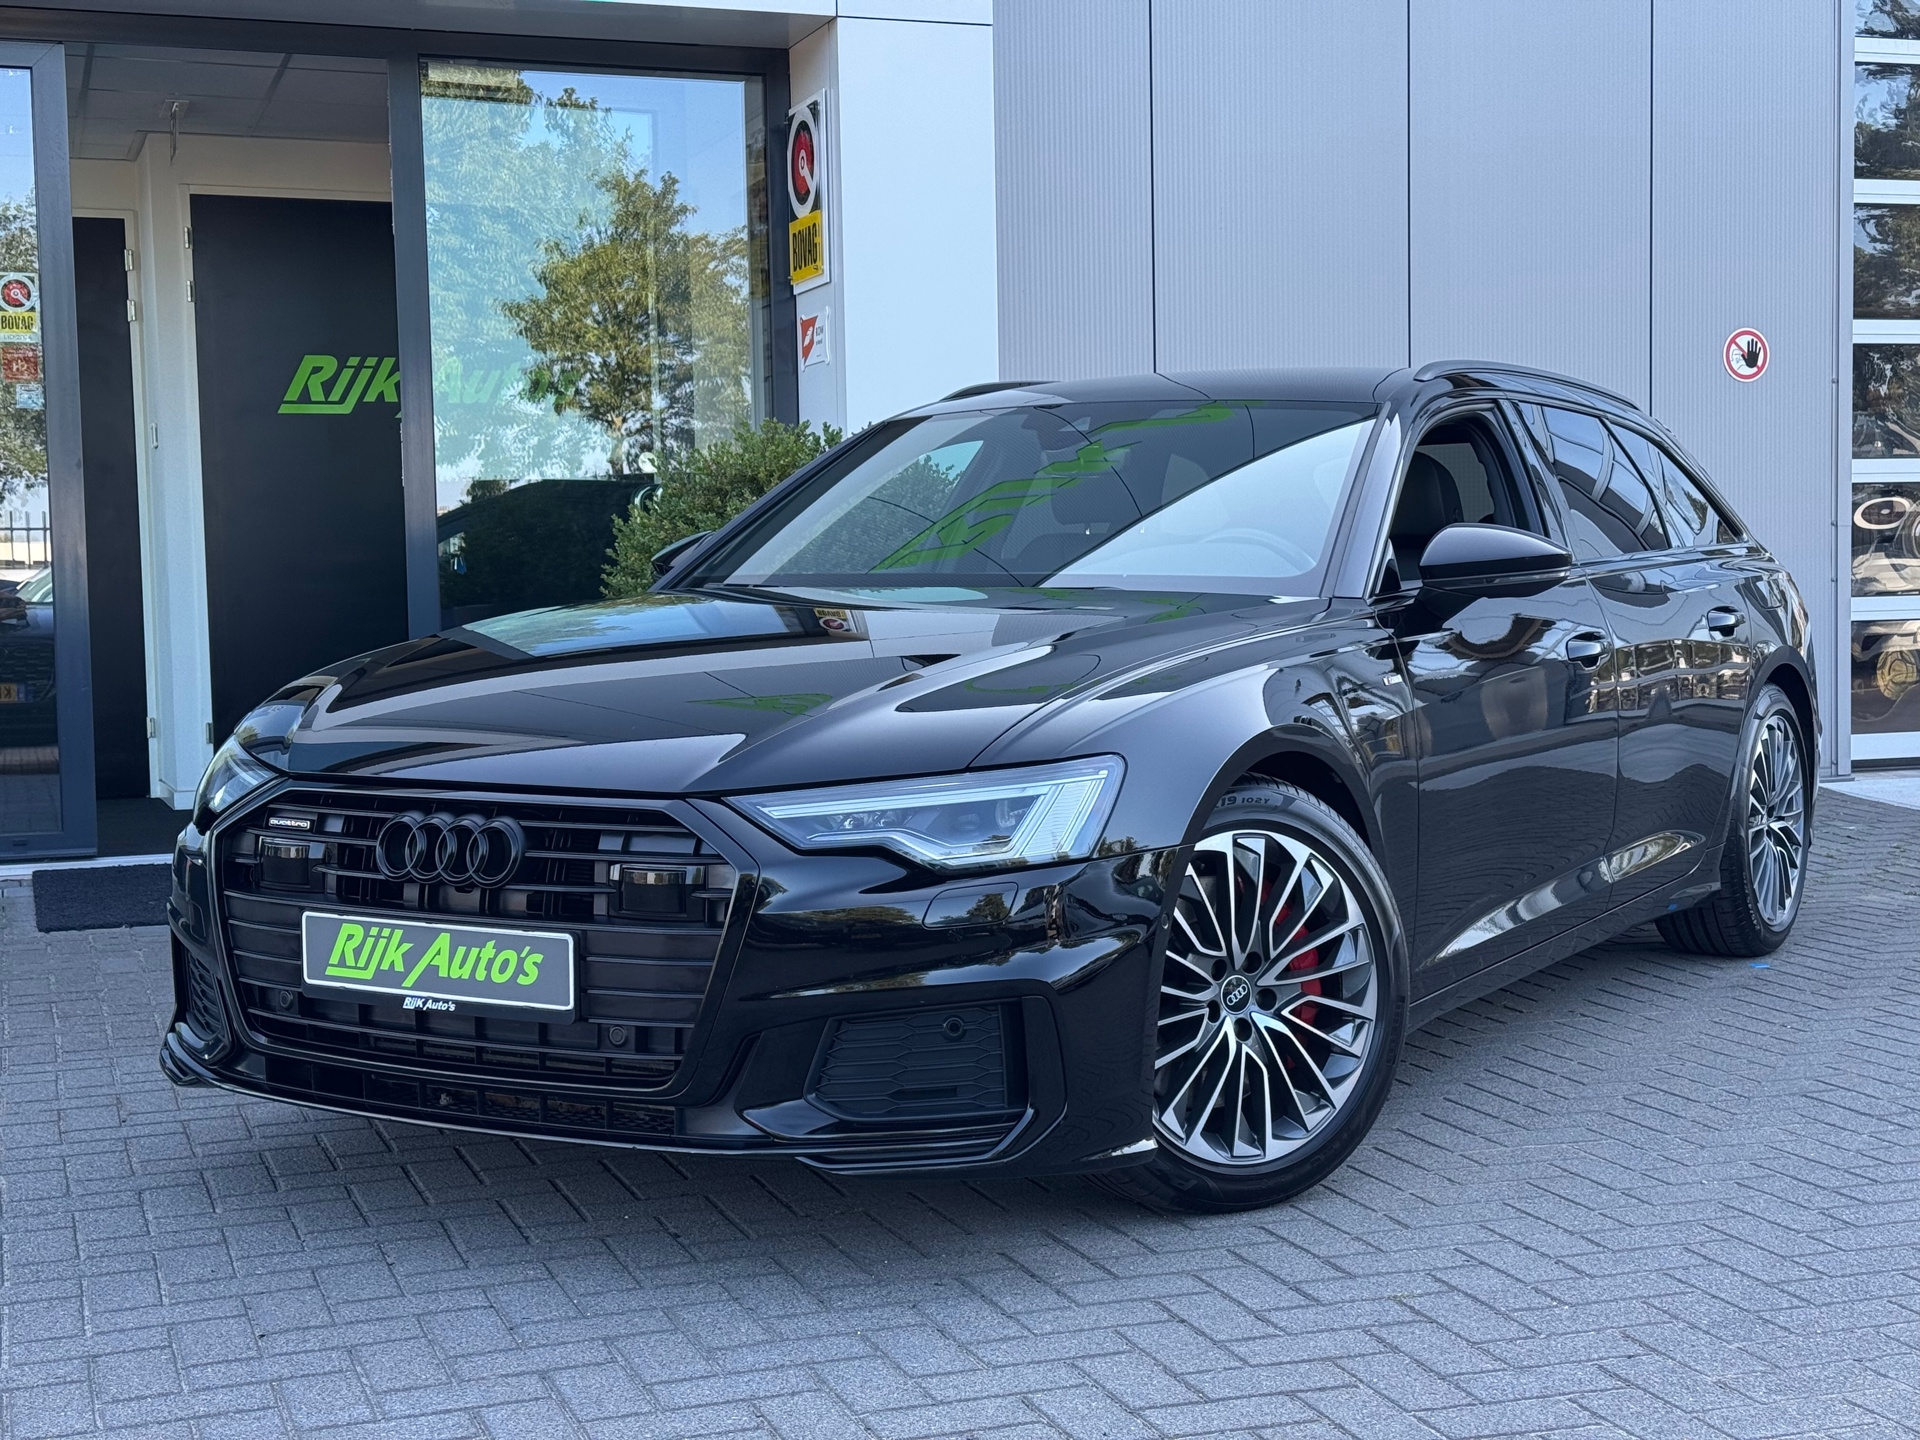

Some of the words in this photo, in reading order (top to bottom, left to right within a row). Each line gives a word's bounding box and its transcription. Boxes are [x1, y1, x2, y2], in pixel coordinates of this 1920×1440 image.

[792, 222, 818, 272] BOVAG
[0, 315, 34, 331] BOVAG
[277, 354, 401, 414] Rijk
[1241, 797, 1271, 805] 102Y
[270, 819, 308, 828] quattro
[324, 922, 414, 980] Rijk
[401, 932, 544, 988] Auto's
[422, 999, 456, 1011] Auto's
